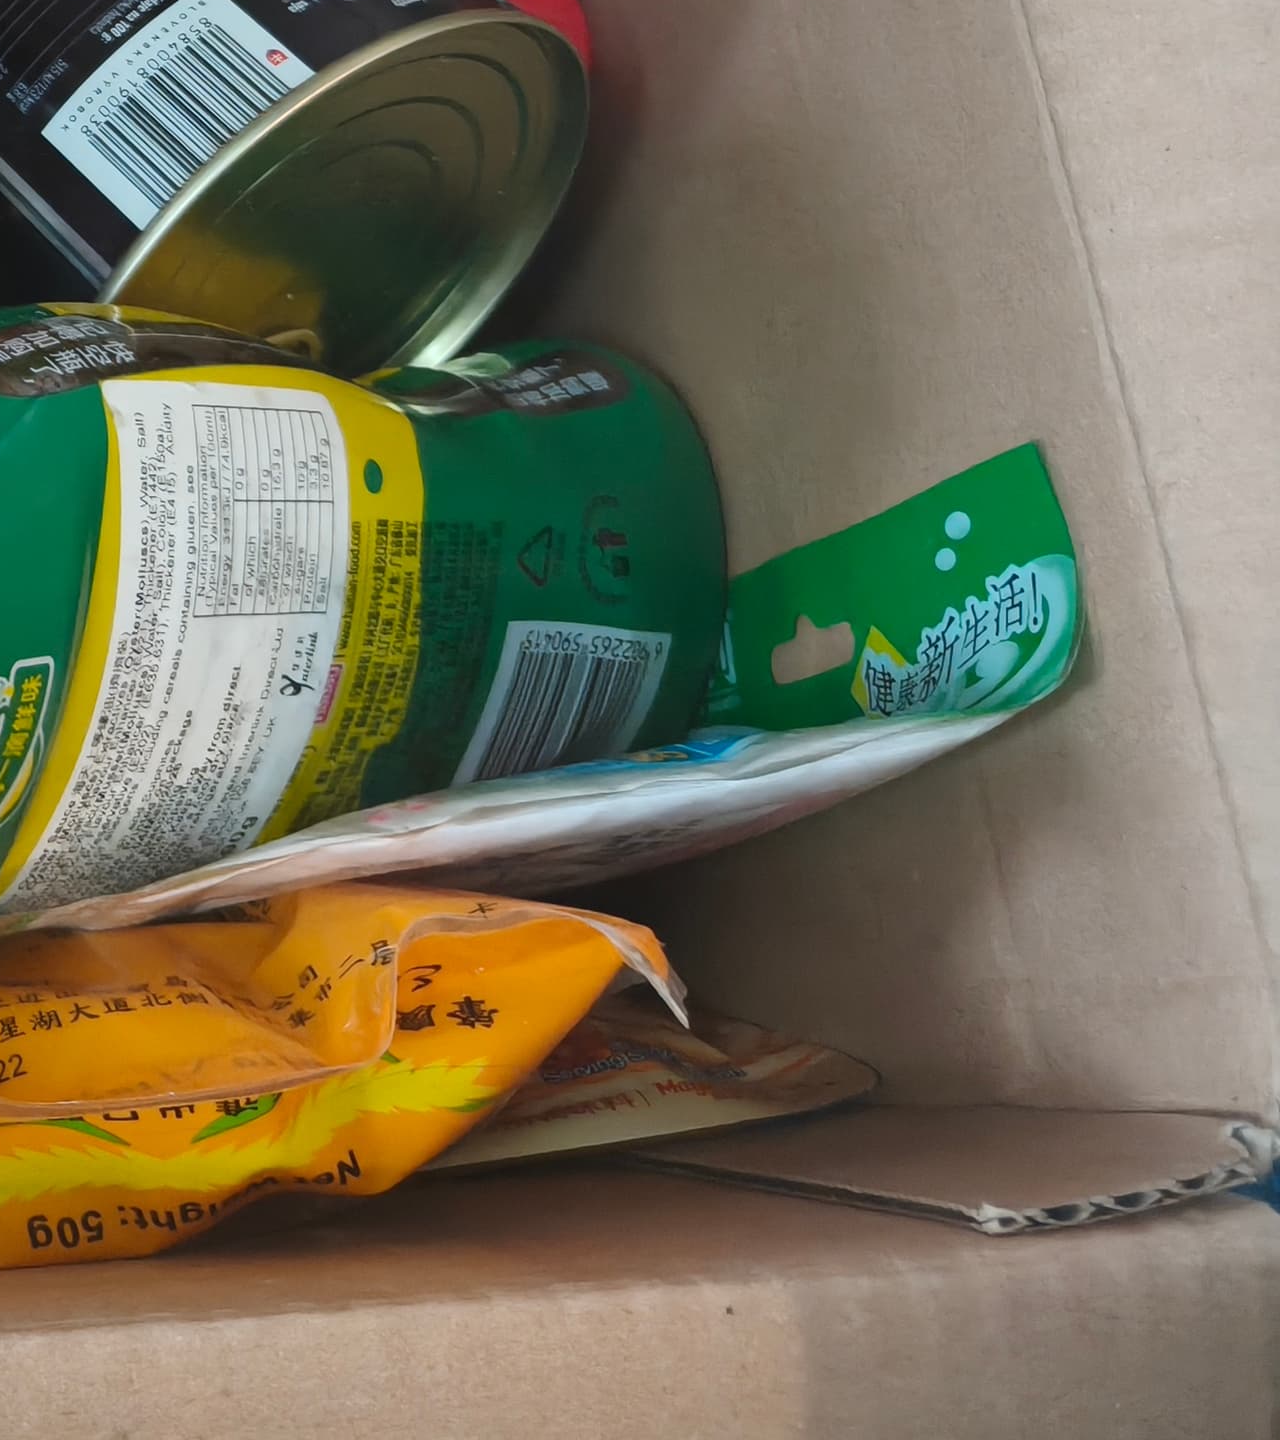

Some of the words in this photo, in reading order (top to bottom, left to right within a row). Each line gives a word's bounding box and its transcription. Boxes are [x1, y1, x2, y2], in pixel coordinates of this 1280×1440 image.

[108, 17, 130, 38] 100
[73, 10, 213, 139] 8584008190038
[197, 446, 211, 527] Information
[196, 534, 208, 596] Nutrition
[217, 553, 231, 606] Energy
[245, 536, 256, 578] which
[178, 560, 196, 643] containing
[864, 571, 1040, 717] 健康新生活!
[23, 1202, 107, 1256] 50g
